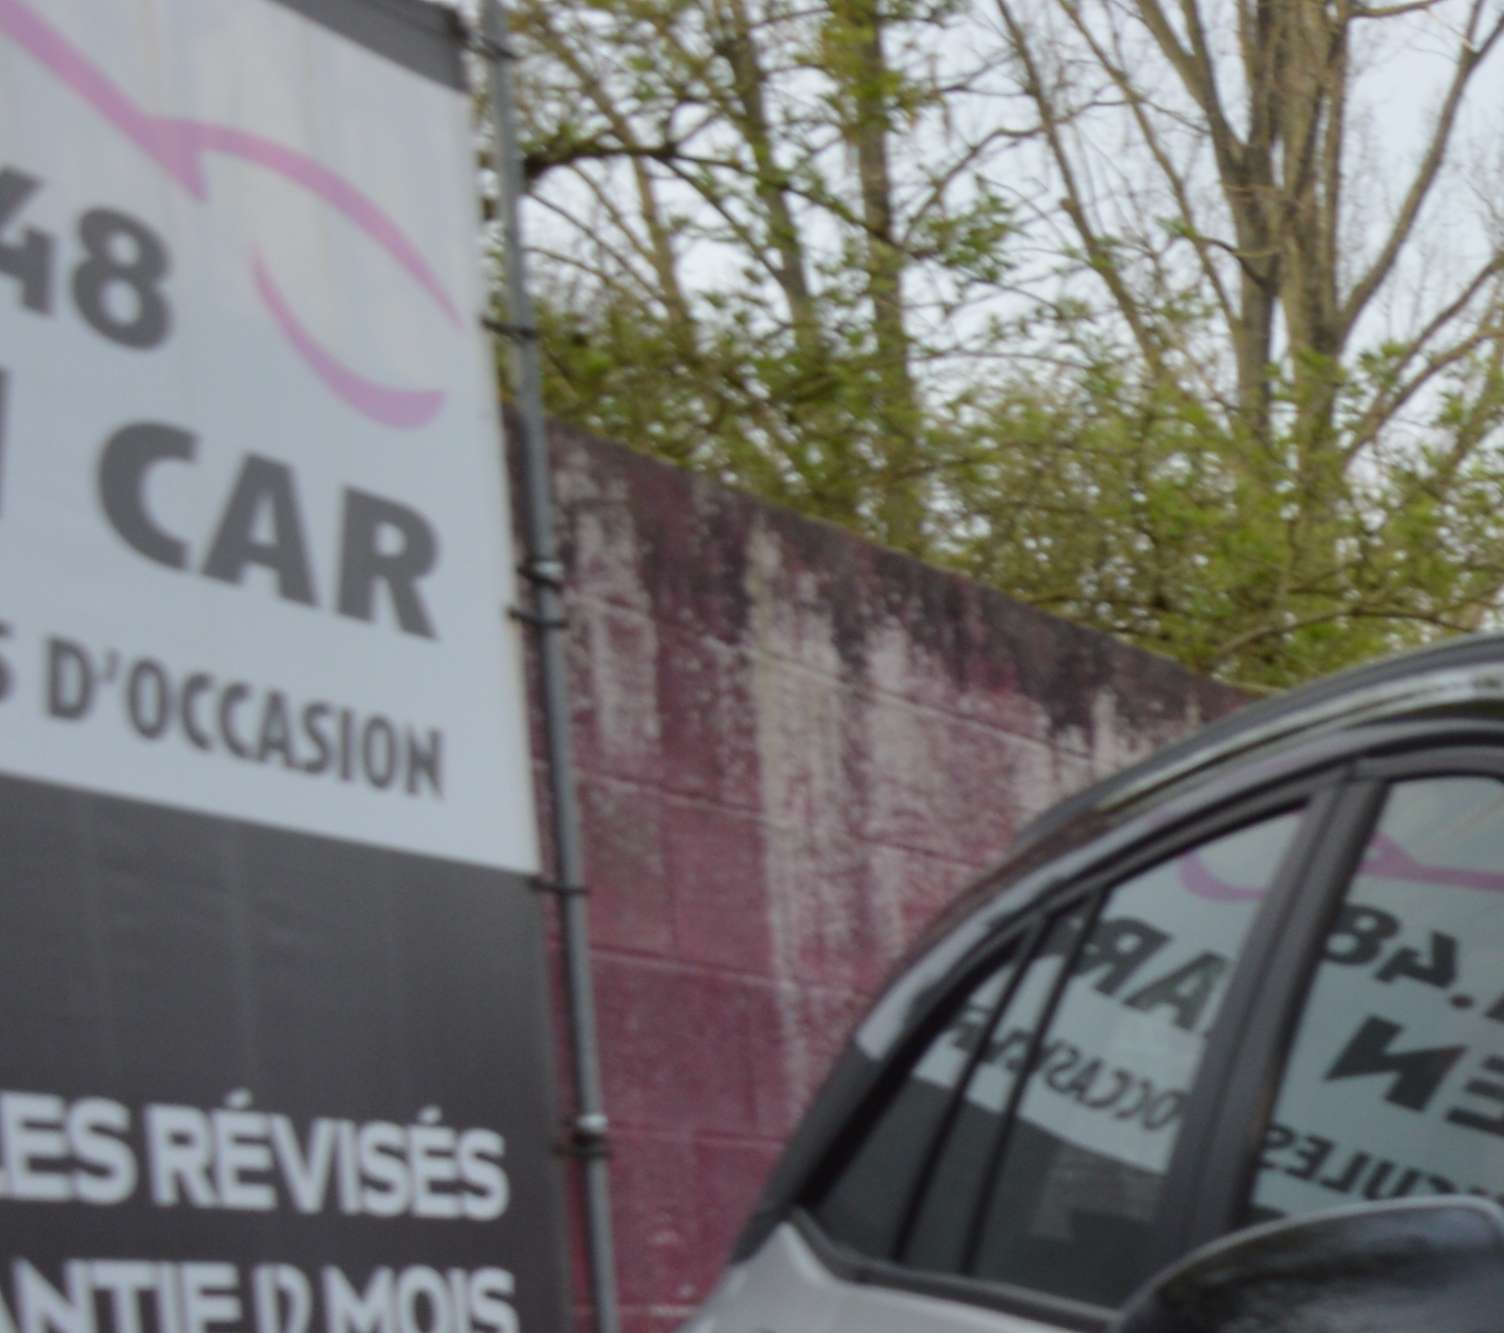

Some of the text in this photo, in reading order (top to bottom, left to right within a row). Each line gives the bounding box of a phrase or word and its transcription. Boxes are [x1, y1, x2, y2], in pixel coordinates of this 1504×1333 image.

[95, 419, 440, 643] CAR
[43, 632, 446, 799] D'OCCASION
[0, 1086, 510, 1221] ES RÉVISÉS
